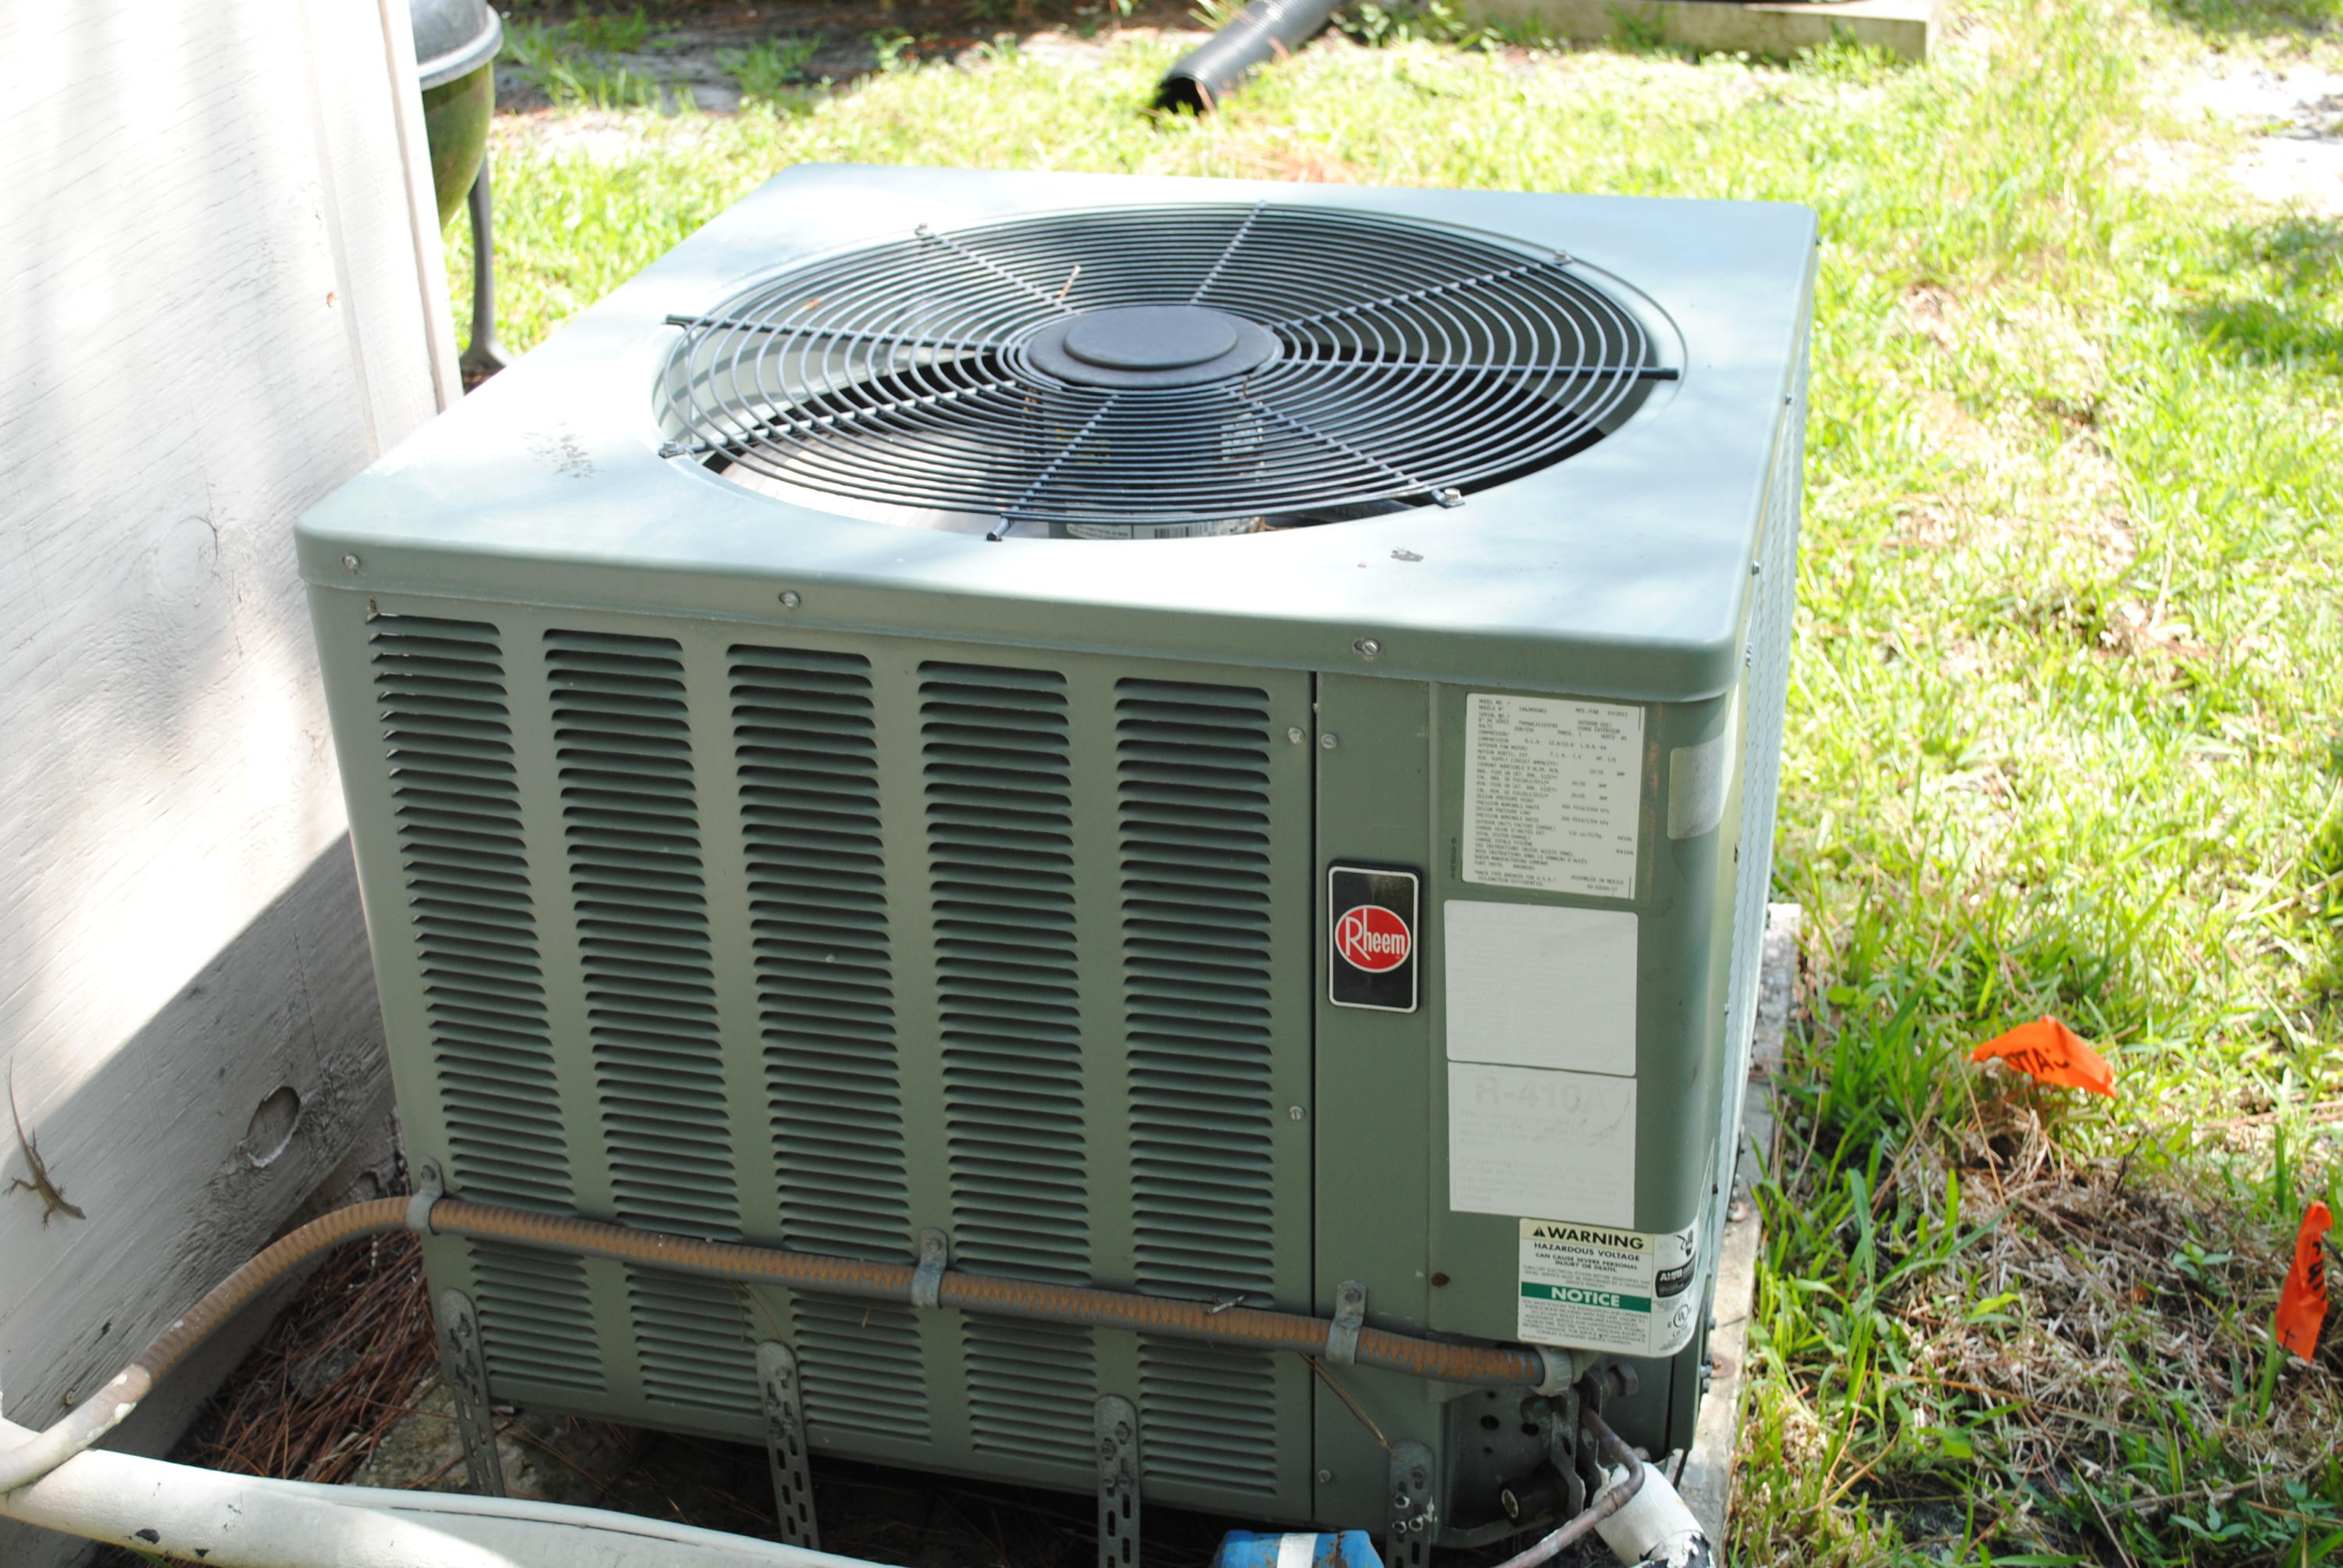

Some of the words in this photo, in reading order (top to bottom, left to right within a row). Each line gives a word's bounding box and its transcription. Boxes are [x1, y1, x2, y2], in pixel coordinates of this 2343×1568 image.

[1345, 908, 1405, 960] Rheem
[1475, 1075, 1607, 1116] R-410A
[1547, 1226, 1644, 1249] WARNING
[1534, 1243, 1595, 1256] HAZARDOUS
[1598, 1250, 1640, 1262] VOLTAGE
[1602, 1259, 1637, 1270] PERSONAL
[1551, 1287, 1620, 1307] NOTICE
